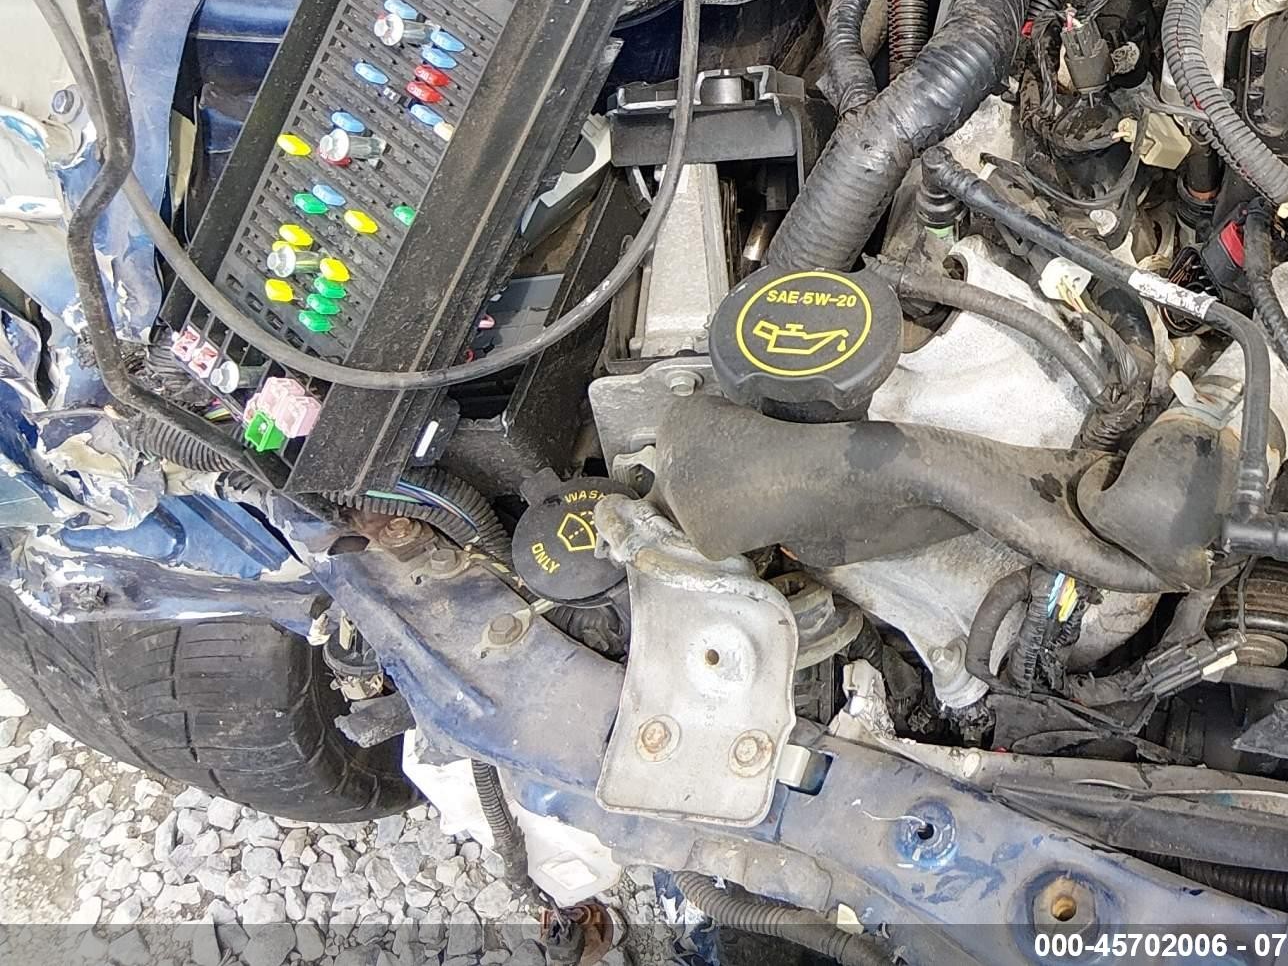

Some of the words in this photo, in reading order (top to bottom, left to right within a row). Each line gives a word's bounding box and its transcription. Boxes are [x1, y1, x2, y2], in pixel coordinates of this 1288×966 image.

[766, 289, 800, 304] SAE
[803, 291, 857, 308] 5W-20
[531, 542, 560, 574] ONLY
